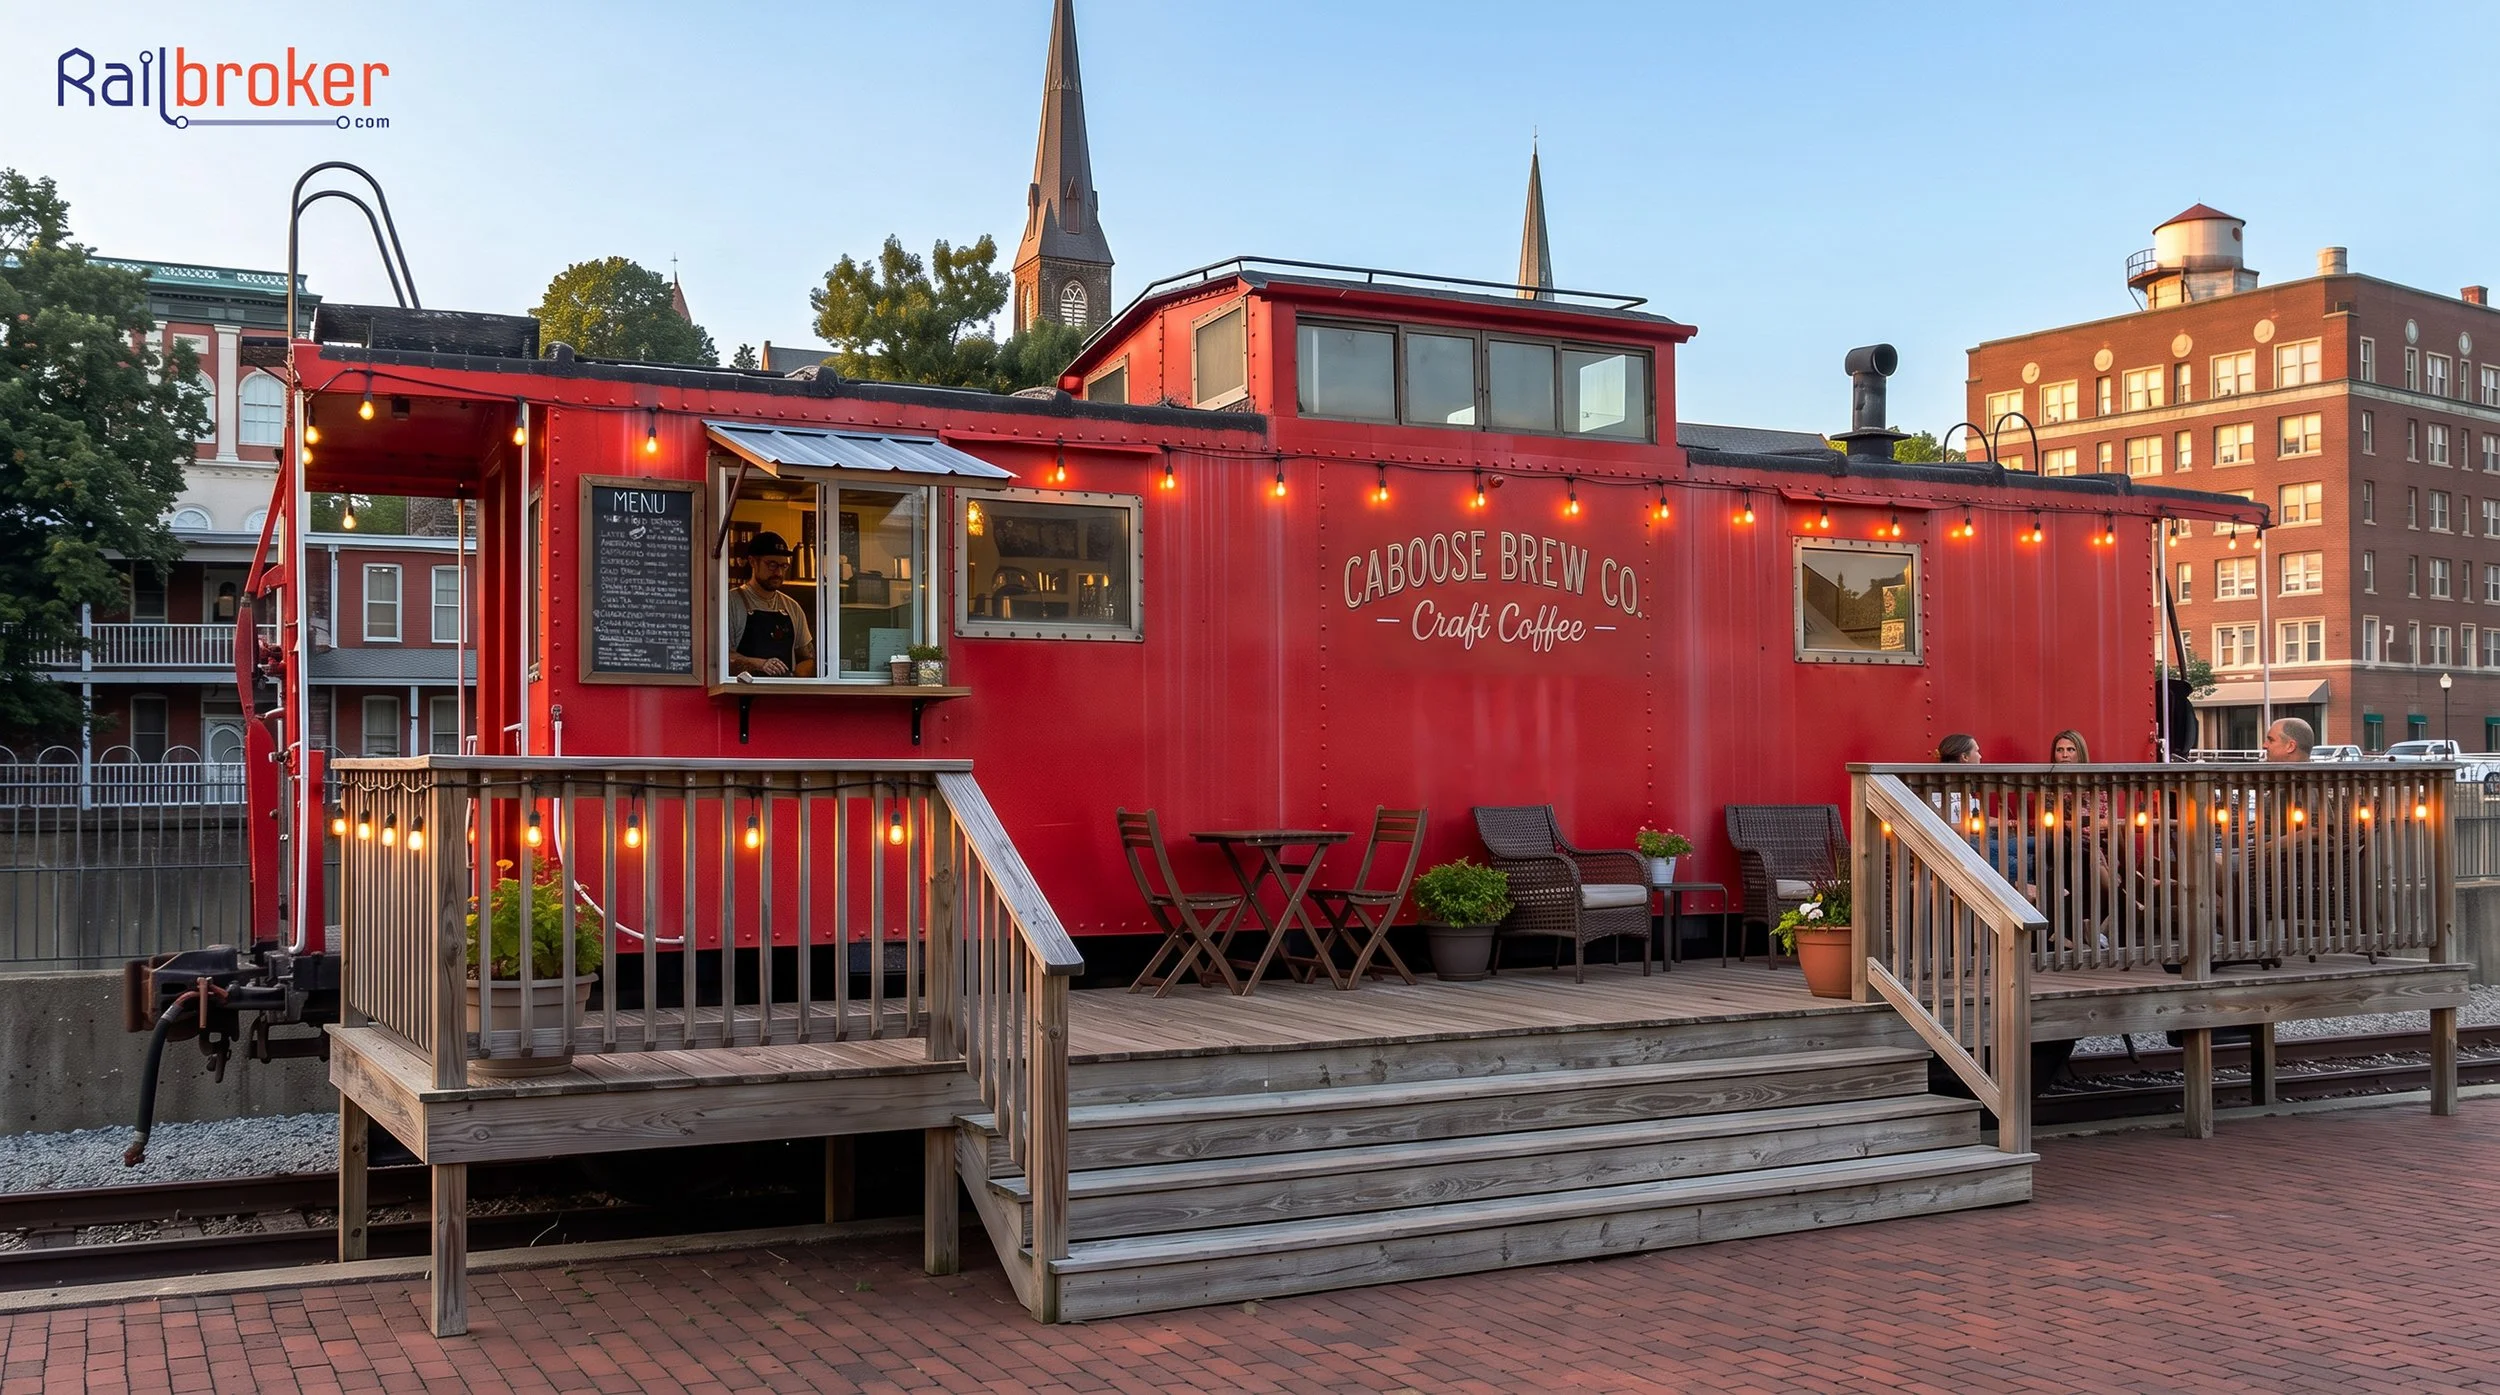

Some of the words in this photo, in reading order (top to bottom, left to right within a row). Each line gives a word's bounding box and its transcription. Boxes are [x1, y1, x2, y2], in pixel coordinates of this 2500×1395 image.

[613, 491, 666, 514] MENU
[1343, 530, 1487, 609] CABOOSE
[1500, 531, 1588, 596] BREW
[1601, 558, 1644, 619] CO.
[1411, 599, 1491, 650] Craft
[1497, 602, 1586, 652] Coffee
